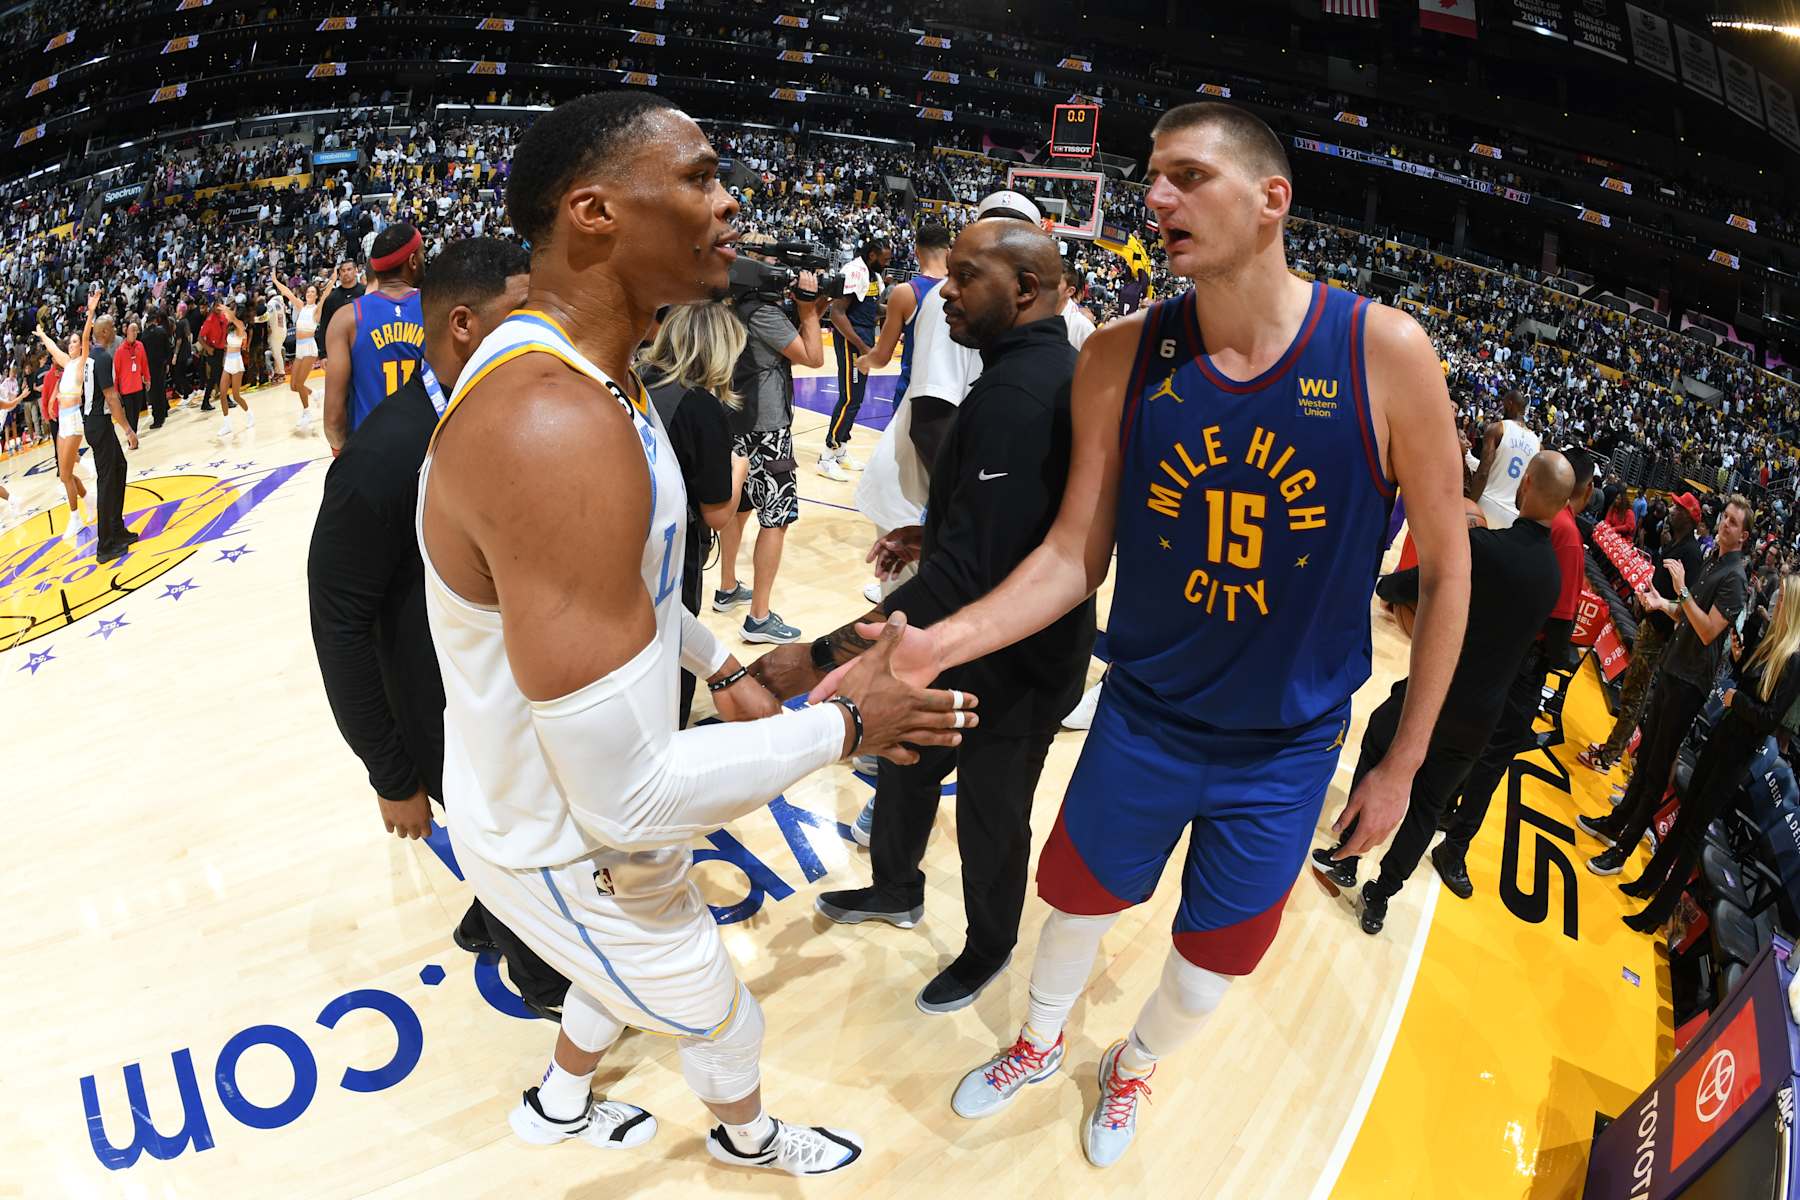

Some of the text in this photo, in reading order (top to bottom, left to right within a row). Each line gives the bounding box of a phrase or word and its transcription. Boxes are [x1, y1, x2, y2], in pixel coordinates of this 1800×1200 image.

[1067, 110, 1086, 122] 0.0
[1341, 148, 1360, 160] 121
[1470, 179, 1487, 191] 110
[104, 185, 141, 202] Spectrum
[370, 321, 425, 350] BROWN
[1160, 339, 1177, 358] 6
[1299, 378, 1338, 398] WU
[1298, 399, 1337, 409] Western
[1304, 407, 1331, 416] Union
[1147, 425, 1327, 531] MILE HIGH
[1507, 456, 1523, 479] 6
[1205, 489, 1267, 569] 15
[1184, 569, 1269, 622] CITY
[1768, 777, 1783, 809] DELTA
